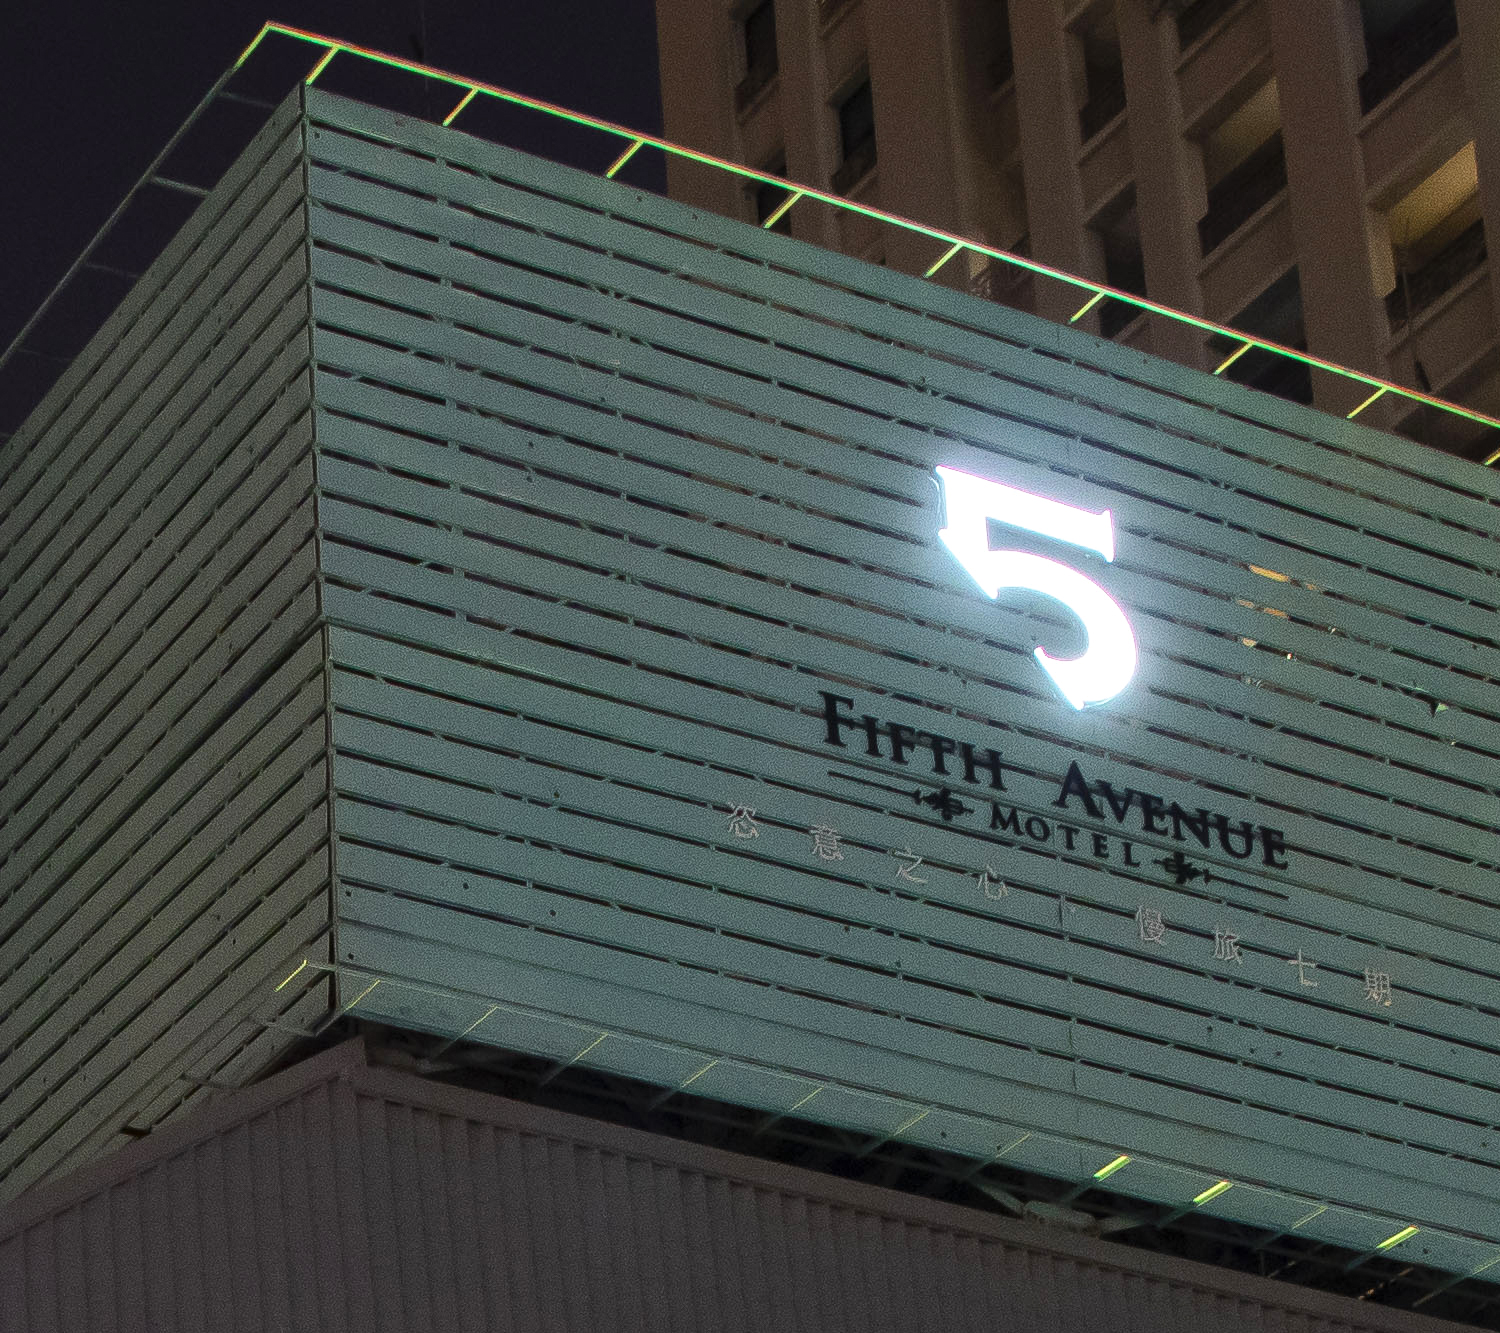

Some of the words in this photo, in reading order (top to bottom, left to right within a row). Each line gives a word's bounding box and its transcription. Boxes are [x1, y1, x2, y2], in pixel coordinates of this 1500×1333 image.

[935, 464, 1139, 710] 5
[817, 690, 1008, 792] FIFTH
[1052, 760, 1289, 871] AVENUE
[990, 805, 1140, 868] MOTEL
